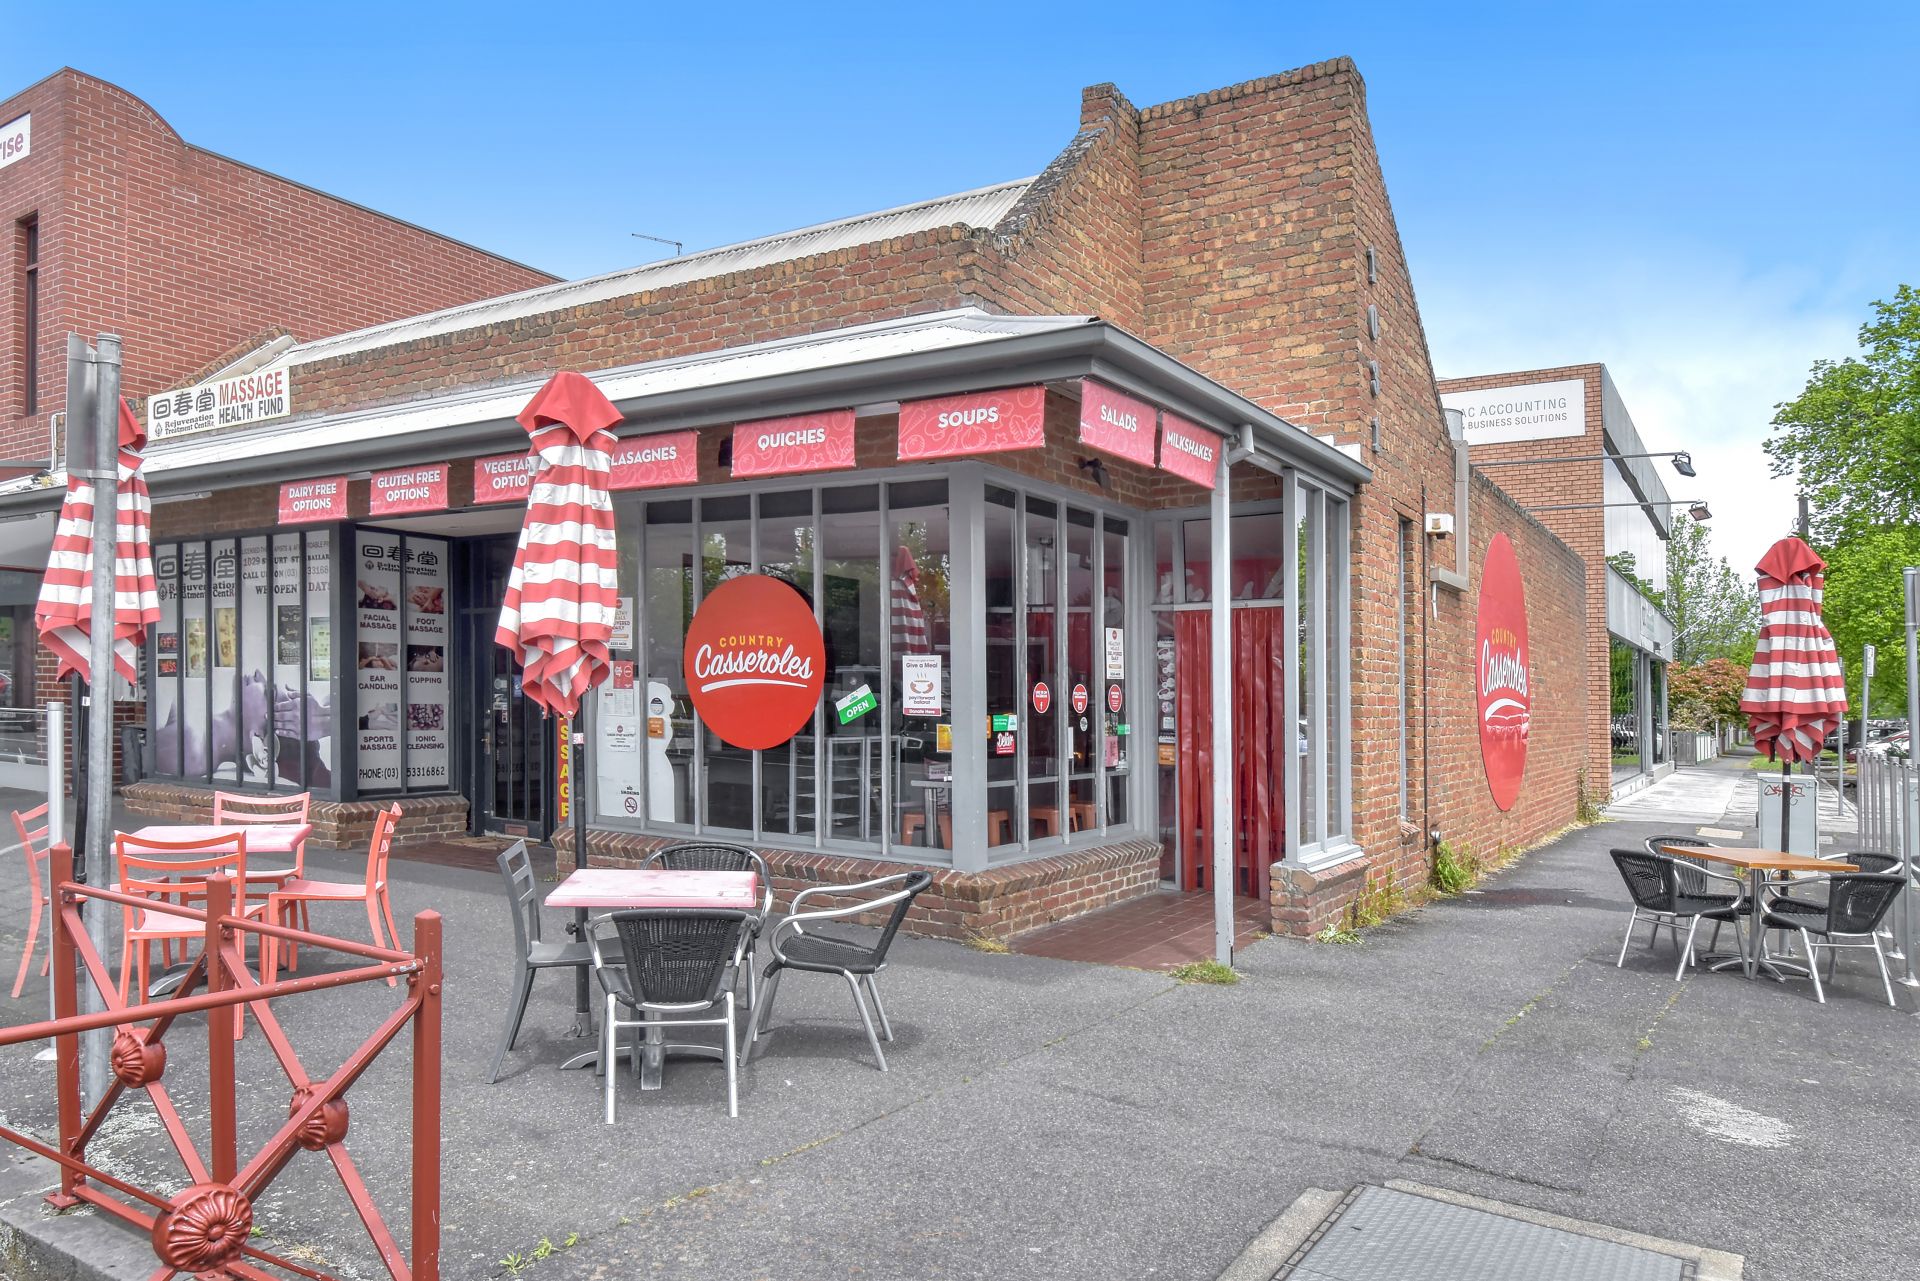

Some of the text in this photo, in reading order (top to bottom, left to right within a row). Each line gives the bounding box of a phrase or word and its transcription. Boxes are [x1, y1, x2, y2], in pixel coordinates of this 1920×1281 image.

[0, 132, 24, 160] ise
[219, 371, 283, 407] MASSAGE
[153, 387, 216, 420] 回春堂
[219, 396, 283, 424] HEALTH FUND
[1480, 397, 1567, 417] ACCOUNTING
[164, 413, 214, 428] Rejuvenation
[937, 406, 999, 429] SOUPS
[1100, 404, 1137, 433] SALADS
[1468, 417, 1512, 429] BUSINESS
[1515, 412, 1567, 425] SOLUTIONS
[165, 424, 194, 435] Treatment
[757, 428, 826, 451] QUICHES
[1166, 431, 1213, 462] MILKSHAKES
[611, 446, 677, 466] LASAGNES
[484, 459, 530, 474] VEGETAR
[377, 470, 440, 488] GLUTEN FREE
[492, 474, 528, 489] OPTIO
[289, 483, 337, 499] DAIRY FREE
[386, 487, 429, 501] OPTIONS
[293, 498, 331, 512] OPTIONS
[261, 556, 288, 565] SURT
[362, 545, 438, 566] 回春堂
[243, 571, 259, 580] CALL
[168, 581, 235, 592] Rjuveatio
[212, 589, 235, 598] CentR
[274, 584, 298, 594] OPEN
[308, 581, 330, 592] DAY
[363, 614, 391, 622] FACIAL
[416, 617, 436, 626] FOOT
[360, 622, 397, 630] MASSAGE
[409, 625, 444, 633] MASSAGE
[719, 635, 783, 648] COUNTRY
[1491, 628, 1516, 650] COUNTRY
[695, 644, 813, 679] Casseroles
[1482, 638, 1527, 698] Casseroles
[358, 682, 398, 690] CANDLING
[409, 676, 442, 684] CUPPING
[846, 699, 869, 718] OPEN
[360, 743, 397, 751] MASSAGE
[407, 742, 445, 750] CLEANSING
[407, 766, 445, 777] 53316862
[559, 715, 570, 817] SSAGE
